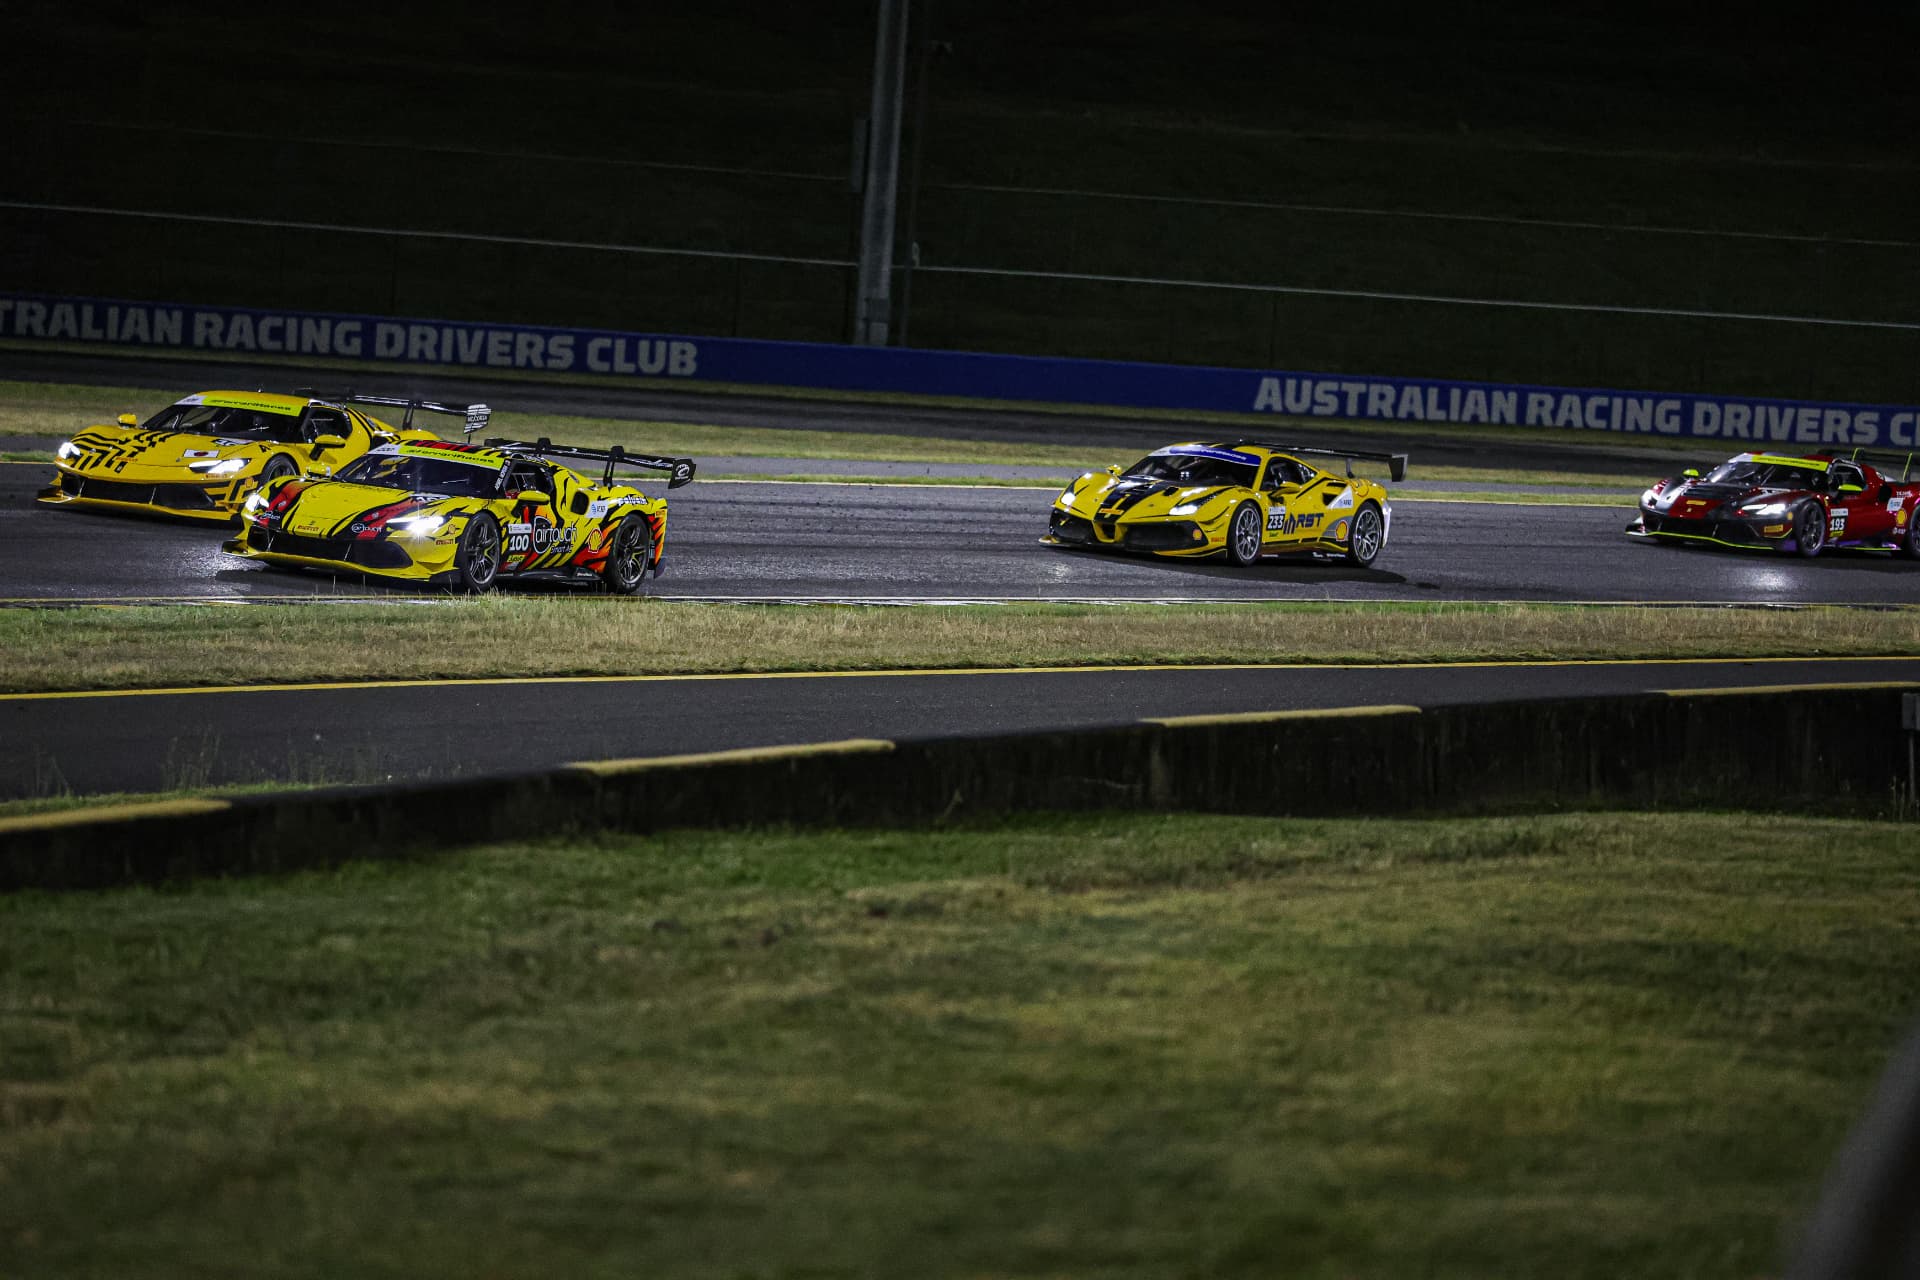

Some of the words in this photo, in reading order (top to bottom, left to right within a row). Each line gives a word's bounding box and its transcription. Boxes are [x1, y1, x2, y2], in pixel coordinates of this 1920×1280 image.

[193, 312, 362, 356] RACING
[375, 323, 575, 370] DRIVERS
[586, 337, 698, 376] CLUB
[1253, 377, 1518, 424] AUSTRALIAN
[1526, 393, 1681, 434] RACING
[1692, 401, 1880, 445] DRIVERS
[1267, 515, 1284, 529] 233
[1296, 513, 1324, 528] RST
[1829, 518, 1845, 531] 193
[509, 534, 530, 551] 100
